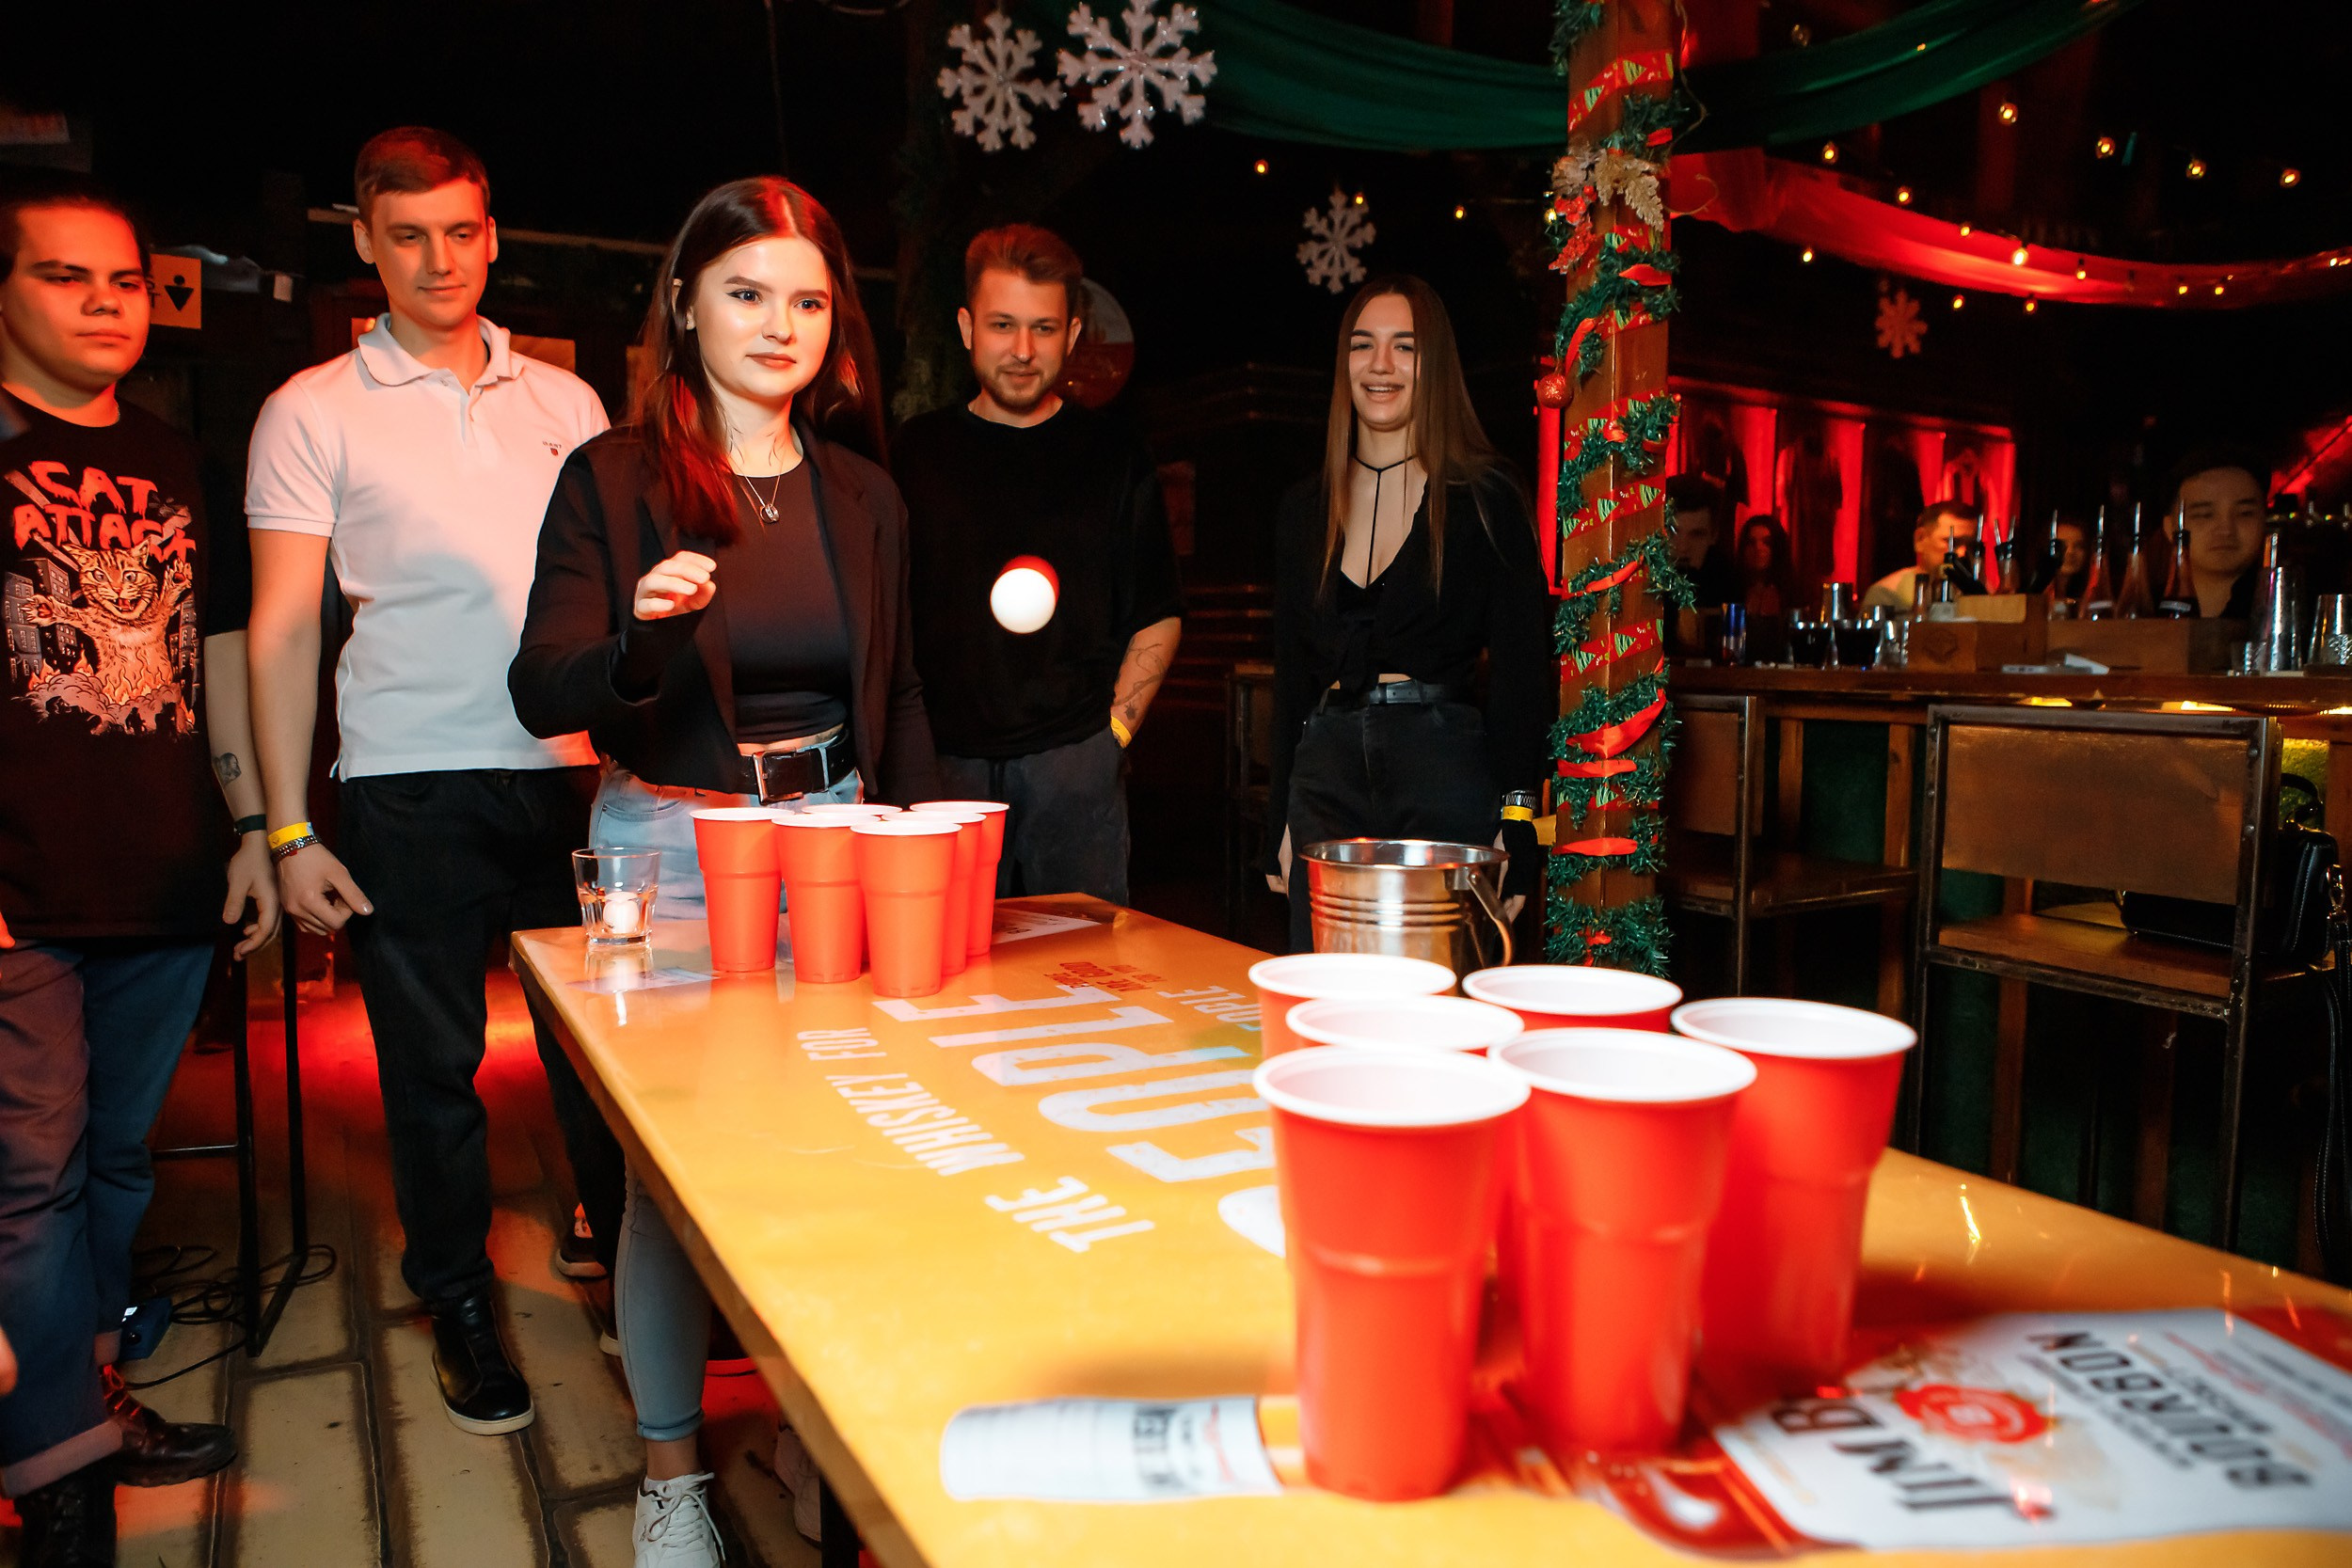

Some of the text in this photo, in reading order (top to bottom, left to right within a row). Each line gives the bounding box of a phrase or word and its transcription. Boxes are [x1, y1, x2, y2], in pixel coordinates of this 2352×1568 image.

[13, 503, 197, 563] ATTACK
[28, 460, 158, 519] CAT
[797, 1026, 1155, 1253] THE WHISKEY FOR
[2026, 1331, 2312, 1489] BOURBON
